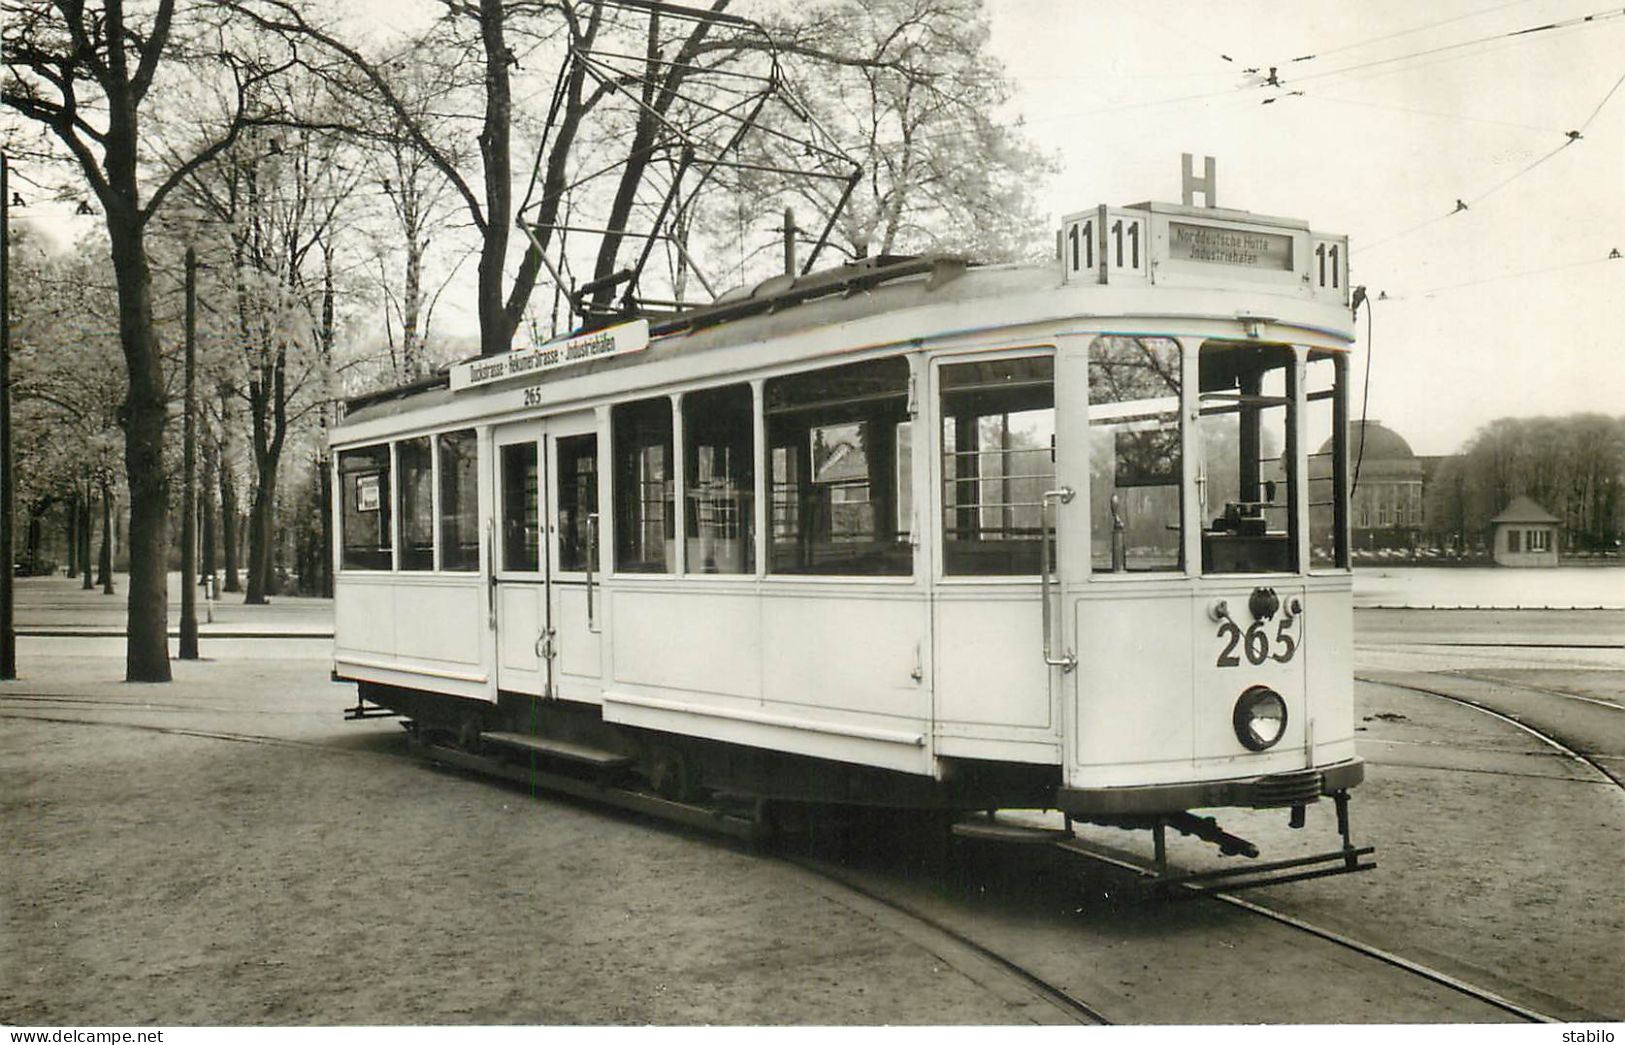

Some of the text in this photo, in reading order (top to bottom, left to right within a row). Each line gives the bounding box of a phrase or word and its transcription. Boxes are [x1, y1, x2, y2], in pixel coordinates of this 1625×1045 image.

[1181, 152, 1216, 208] H
[1069, 220, 1093, 271] 11
[1111, 219, 1139, 269] 11
[1177, 228, 1242, 250] Norddeutsche
[1315, 243, 1339, 288] 11
[524, 387, 542, 406] 265
[1217, 619, 1295, 667] 265
